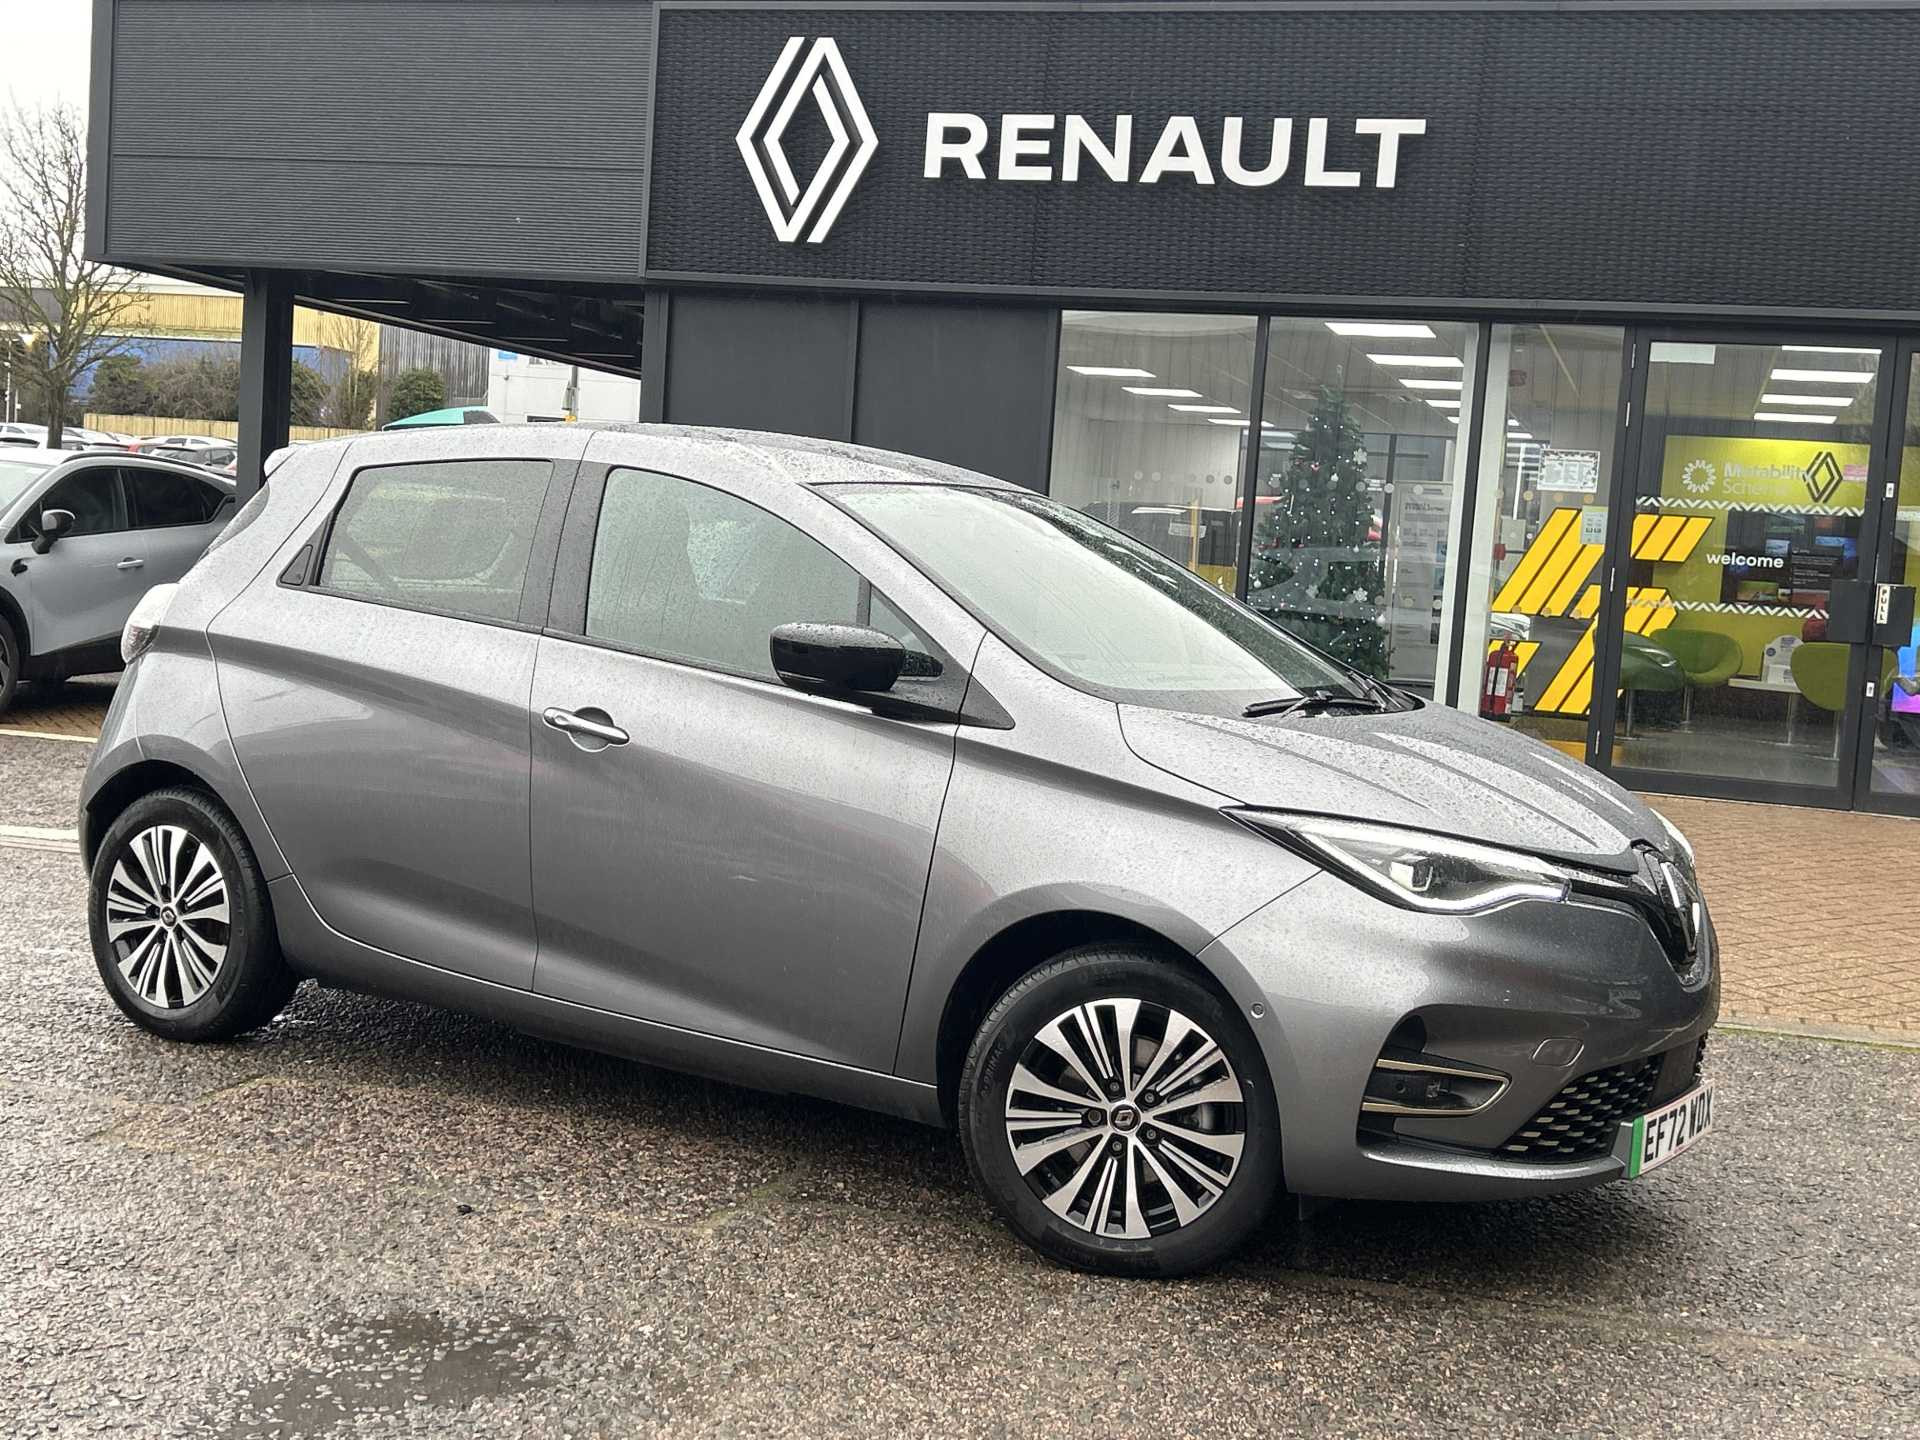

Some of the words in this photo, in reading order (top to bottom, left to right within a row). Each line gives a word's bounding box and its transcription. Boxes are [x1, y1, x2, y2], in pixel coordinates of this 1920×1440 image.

[923, 112, 1427, 189] RENAULT
[1706, 551, 1784, 569] welcome
[1880, 589, 1888, 621] PULL
[1644, 1104, 1687, 1163] EF72
